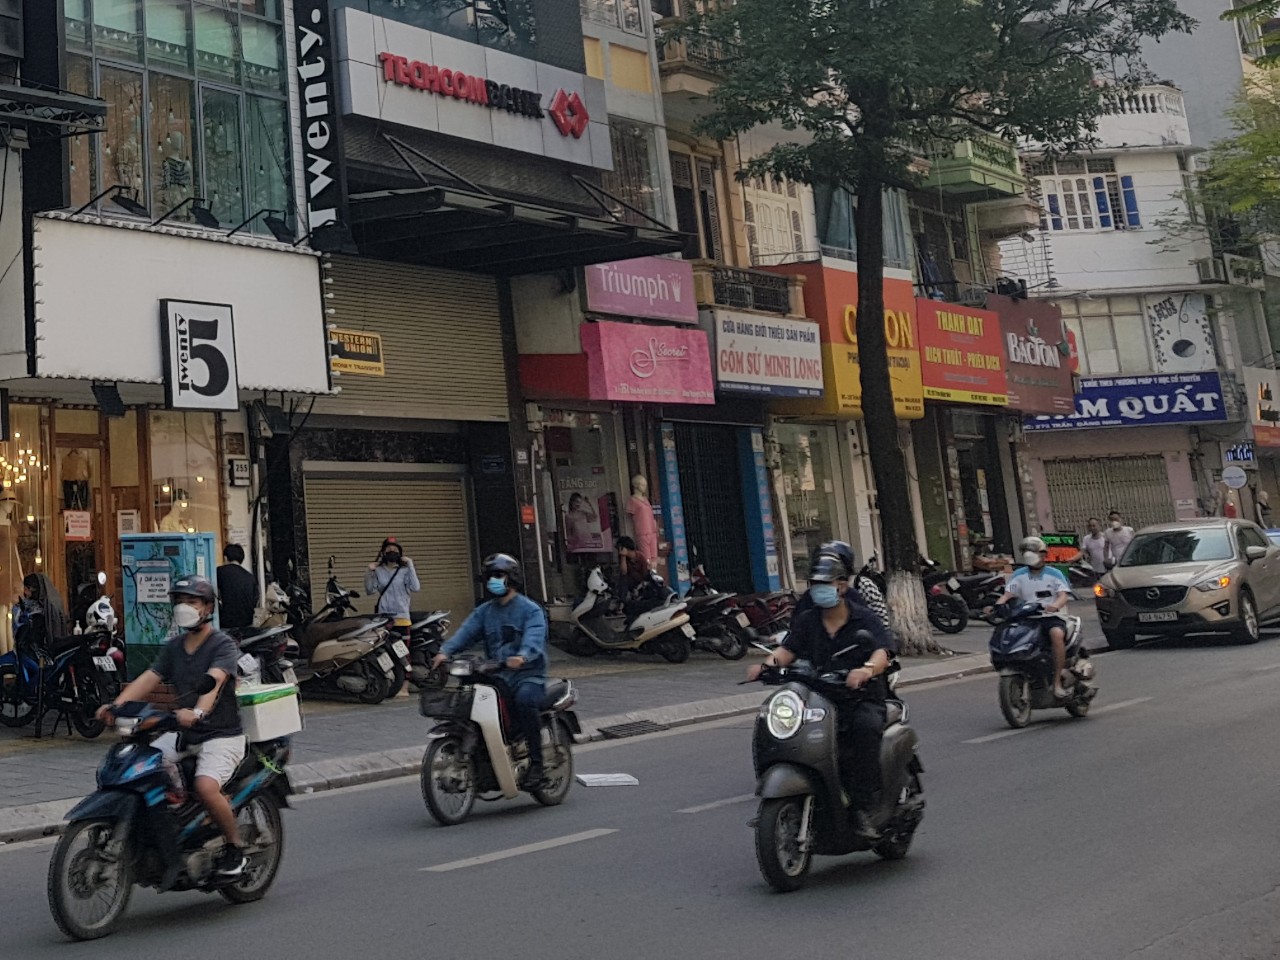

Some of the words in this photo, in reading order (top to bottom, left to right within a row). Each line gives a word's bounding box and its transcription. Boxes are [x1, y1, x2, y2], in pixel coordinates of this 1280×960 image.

[379, 51, 545, 119] TECHCOMBANK
[595, 264, 669, 305] Triumph
[331, 332, 372, 346] WESTERN
[344, 343, 373, 354] UNION
[188, 318, 229, 397] 5
[764, 353, 791, 379] MINH
[793, 356, 820, 381] LONG
[1119, 385, 1219, 419] QUẤT
[236, 464, 248, 472] 255
